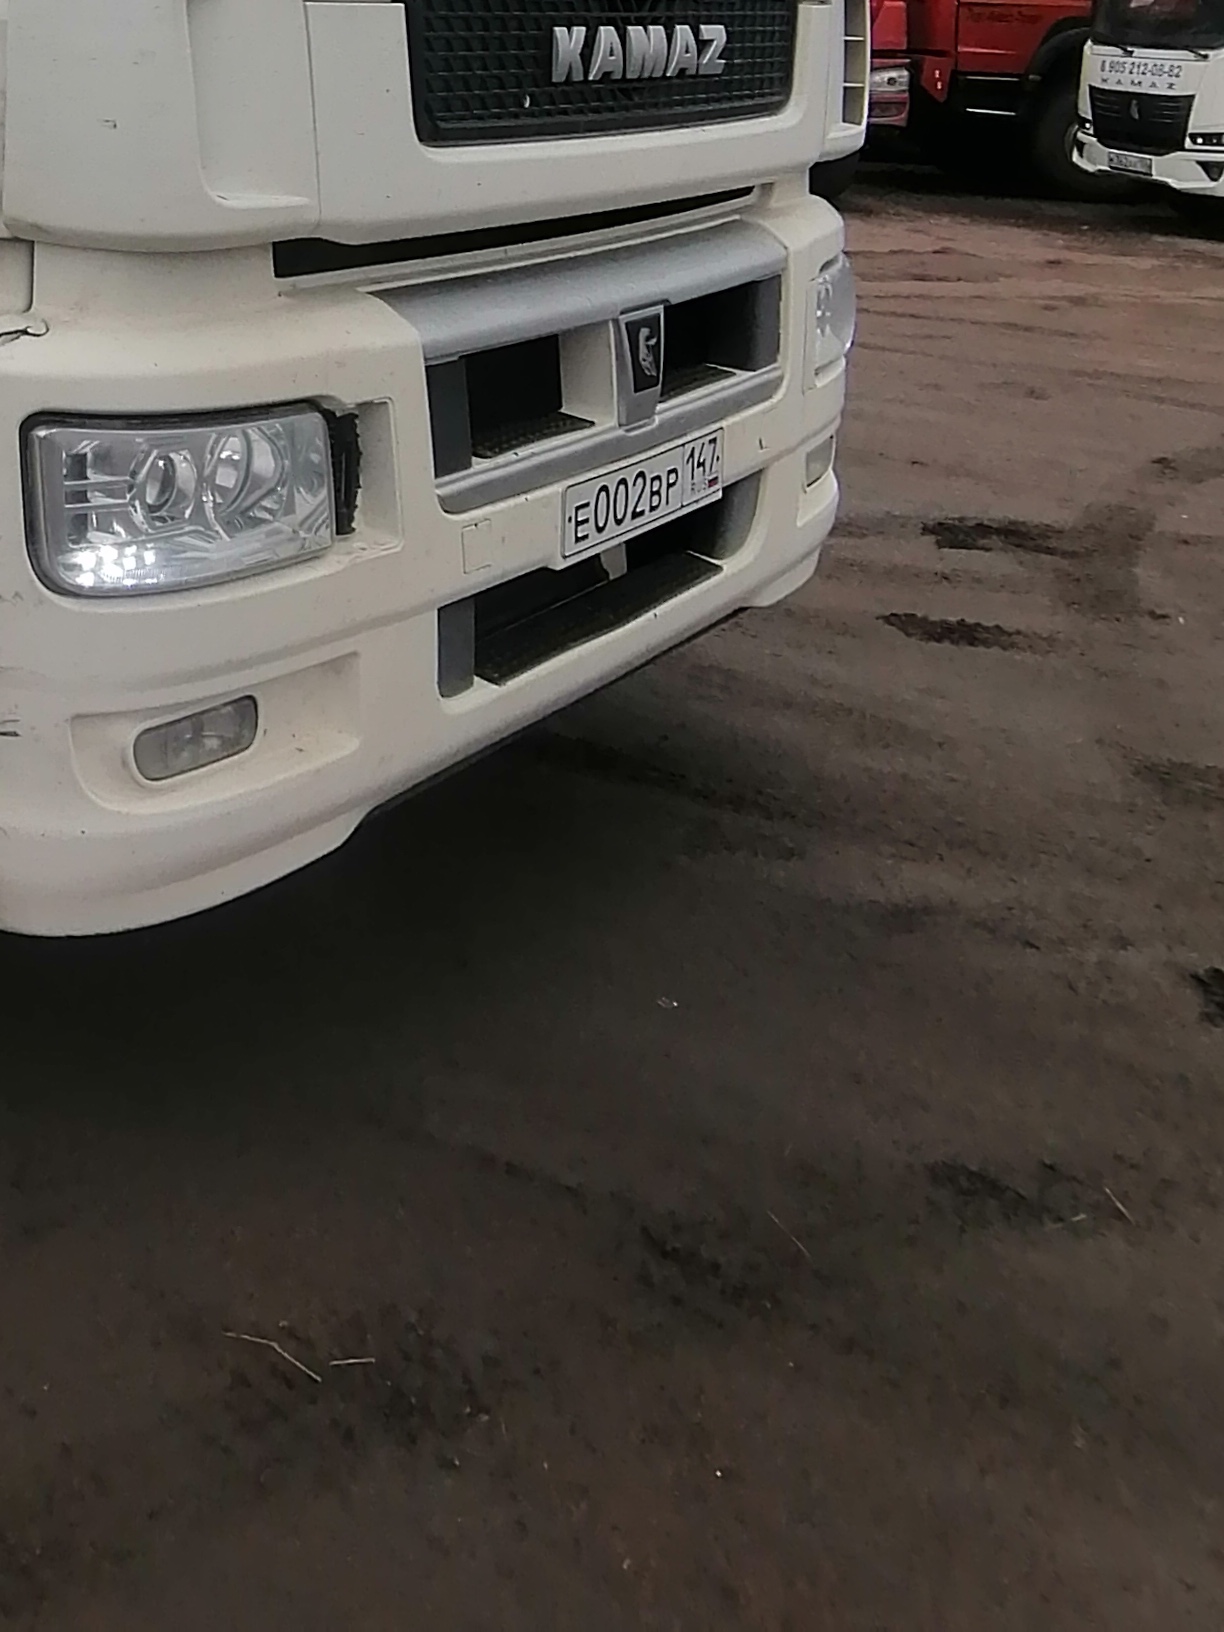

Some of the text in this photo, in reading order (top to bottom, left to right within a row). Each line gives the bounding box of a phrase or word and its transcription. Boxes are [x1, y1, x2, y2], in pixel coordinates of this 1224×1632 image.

[552, 24, 727, 83] KAMAZ
[1108, 60, 1127, 75] 905
[1101, 78, 1177, 90] KAMAZ
[575, 436, 718, 544] E002BP 147
